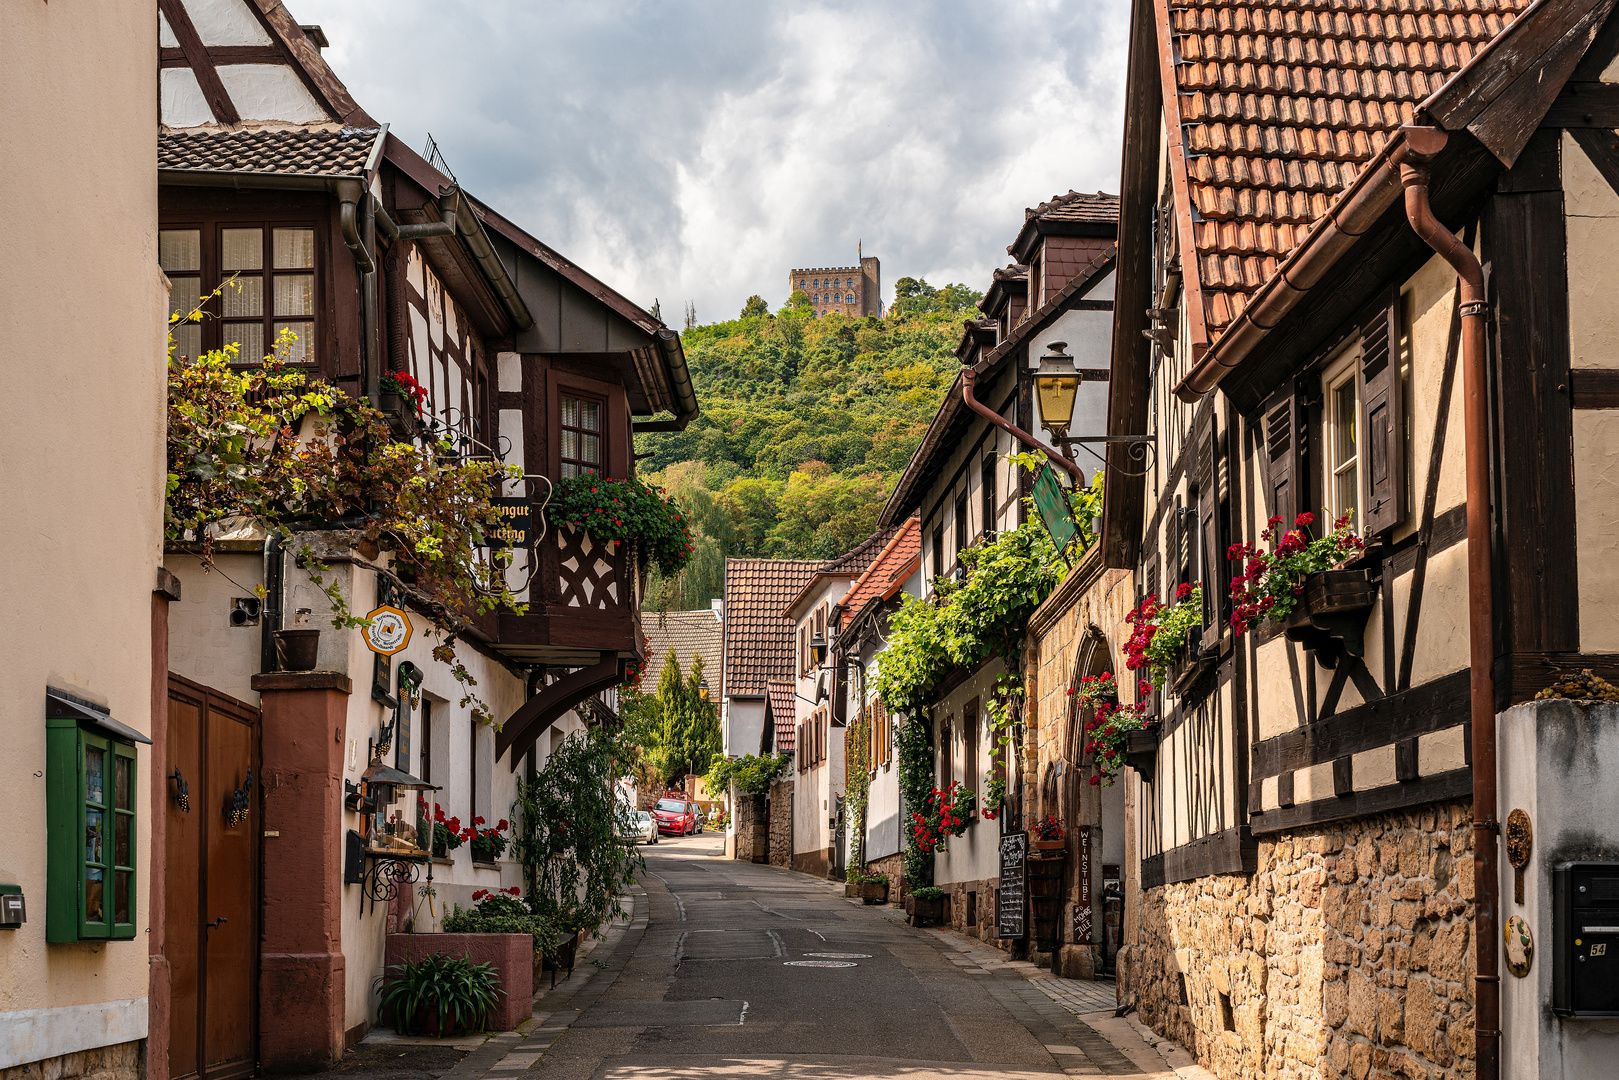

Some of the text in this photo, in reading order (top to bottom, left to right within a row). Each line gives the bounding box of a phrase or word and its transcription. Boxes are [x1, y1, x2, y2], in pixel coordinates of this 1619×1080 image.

[1080, 831, 1089, 902] WEINSTUBE
[1075, 921, 1092, 940] JULE
[1592, 944, 1604, 956] 54
